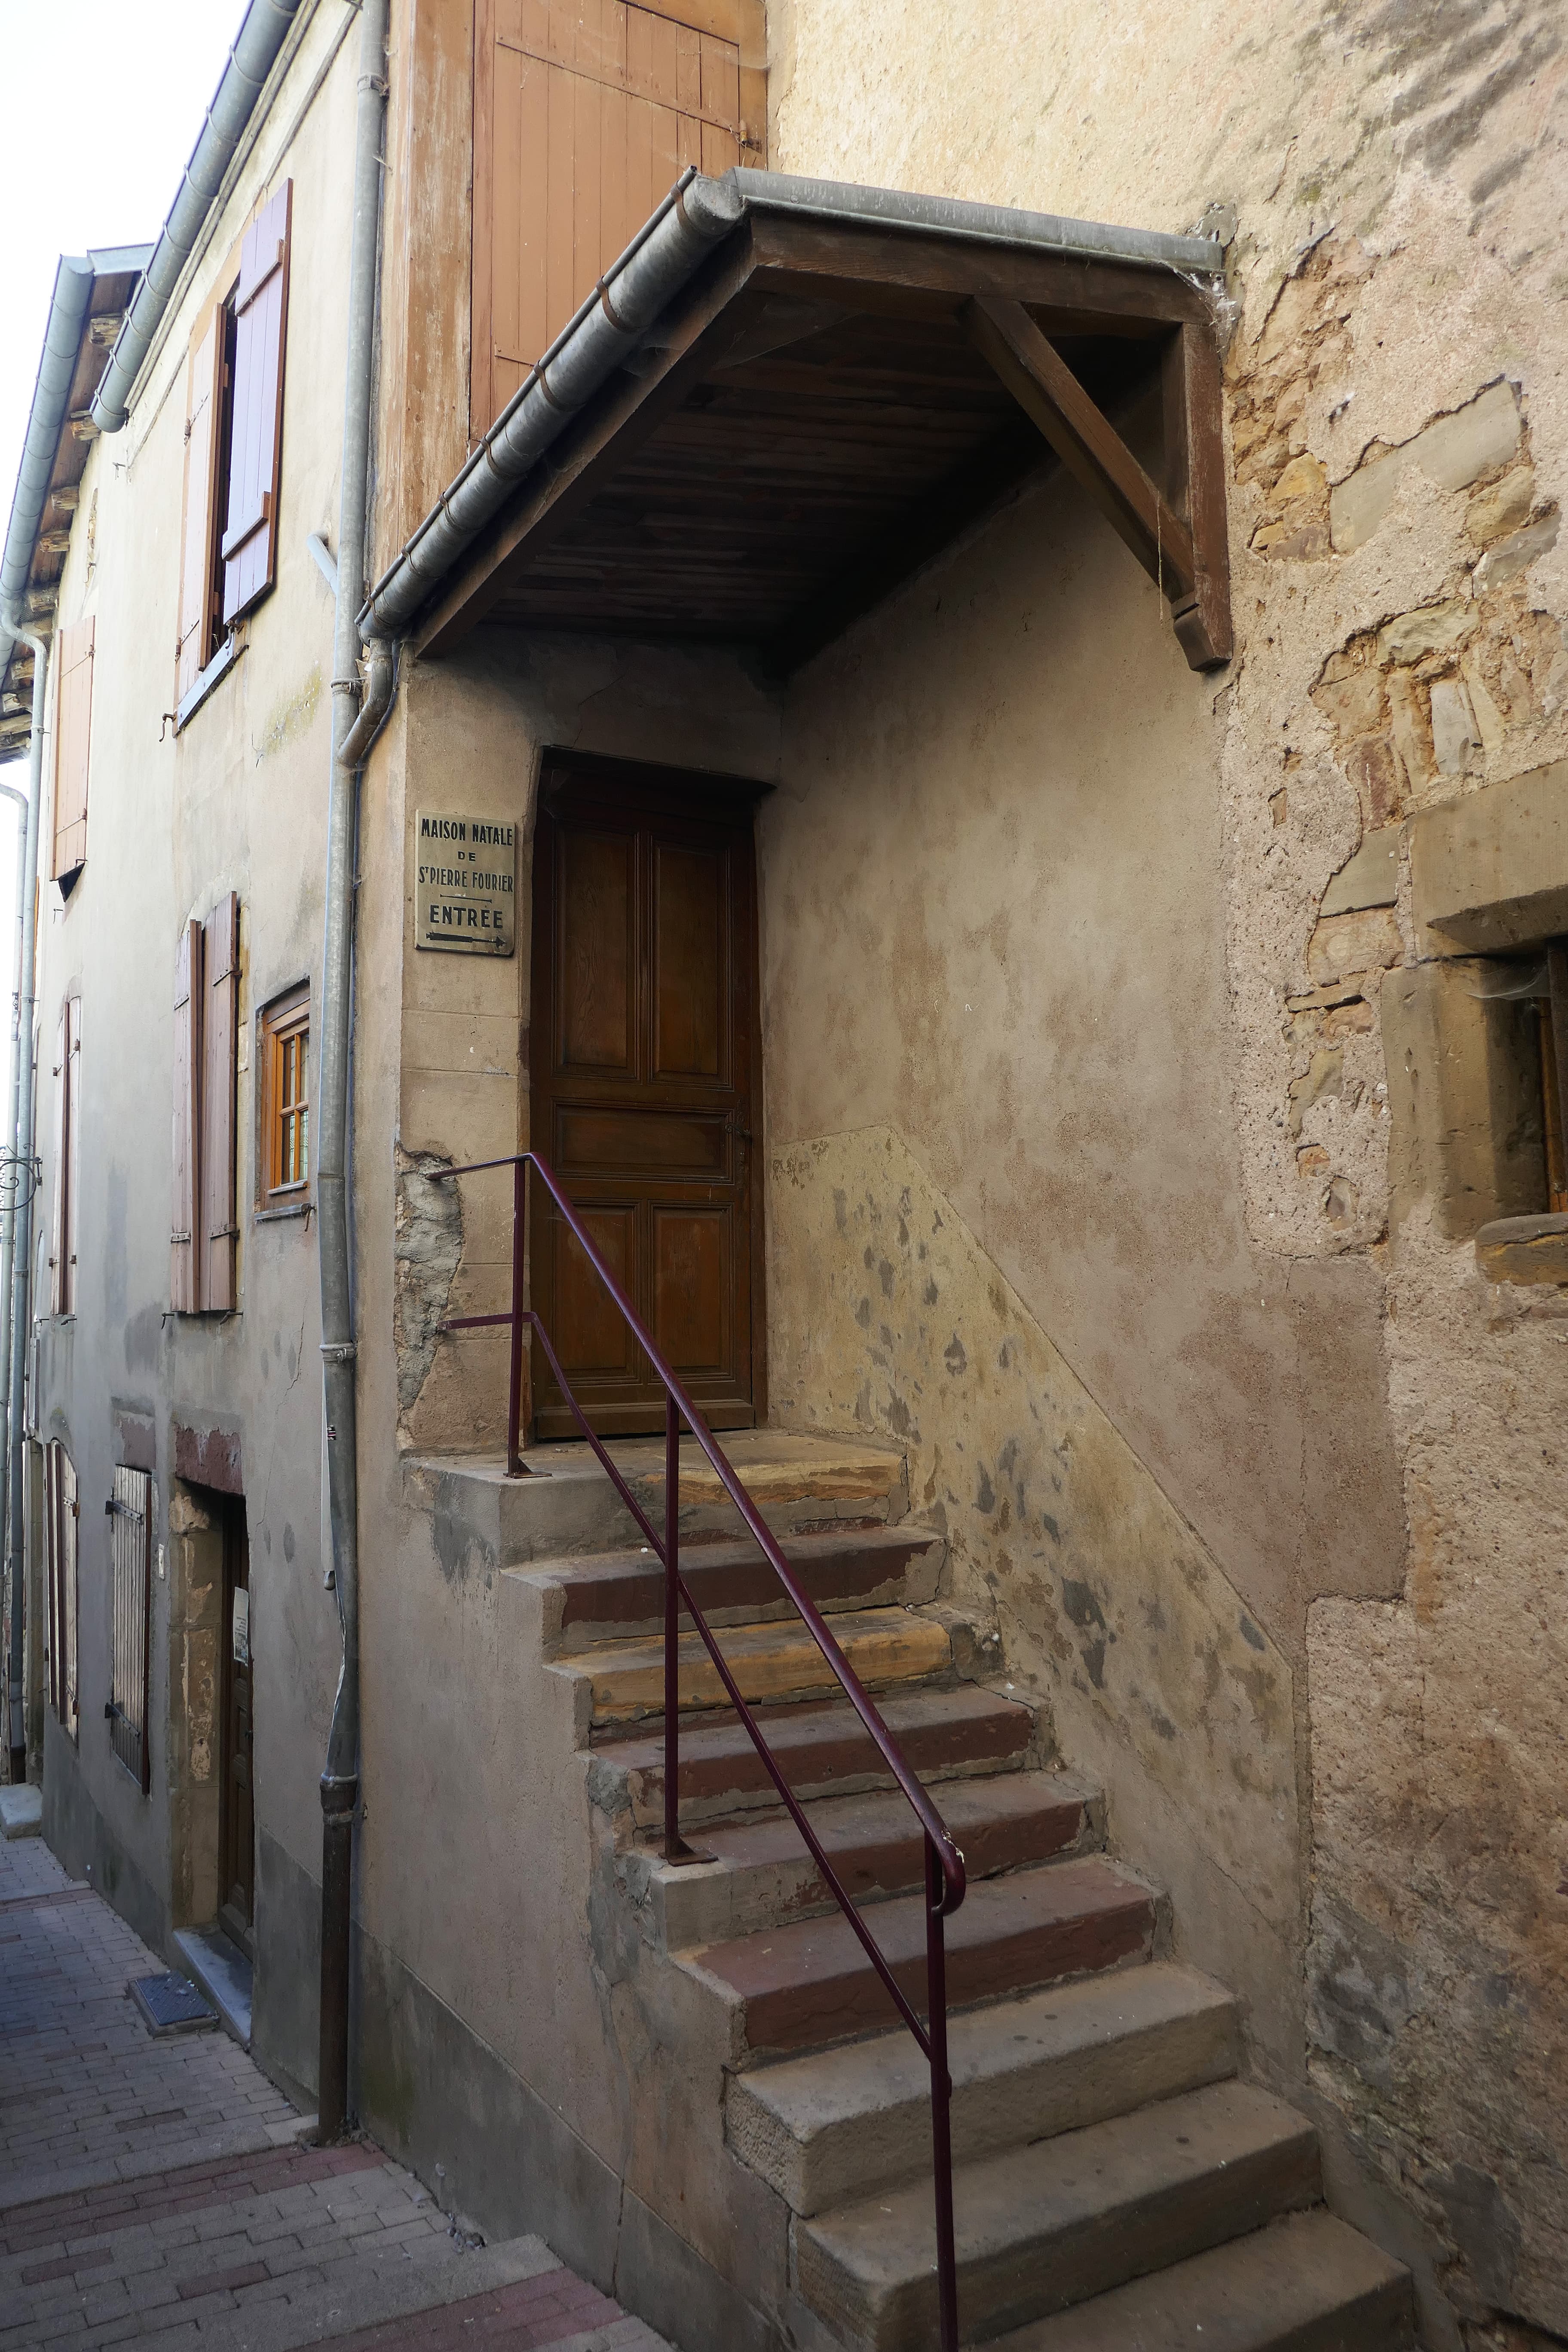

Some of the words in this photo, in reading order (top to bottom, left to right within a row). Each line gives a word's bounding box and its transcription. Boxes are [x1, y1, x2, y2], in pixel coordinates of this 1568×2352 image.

[421, 818, 466, 841] MAISON
[472, 824, 512, 845] NATALE
[458, 851, 476, 861] DE
[430, 869, 467, 888] PIERRE
[472, 872, 513, 892] FOURIER
